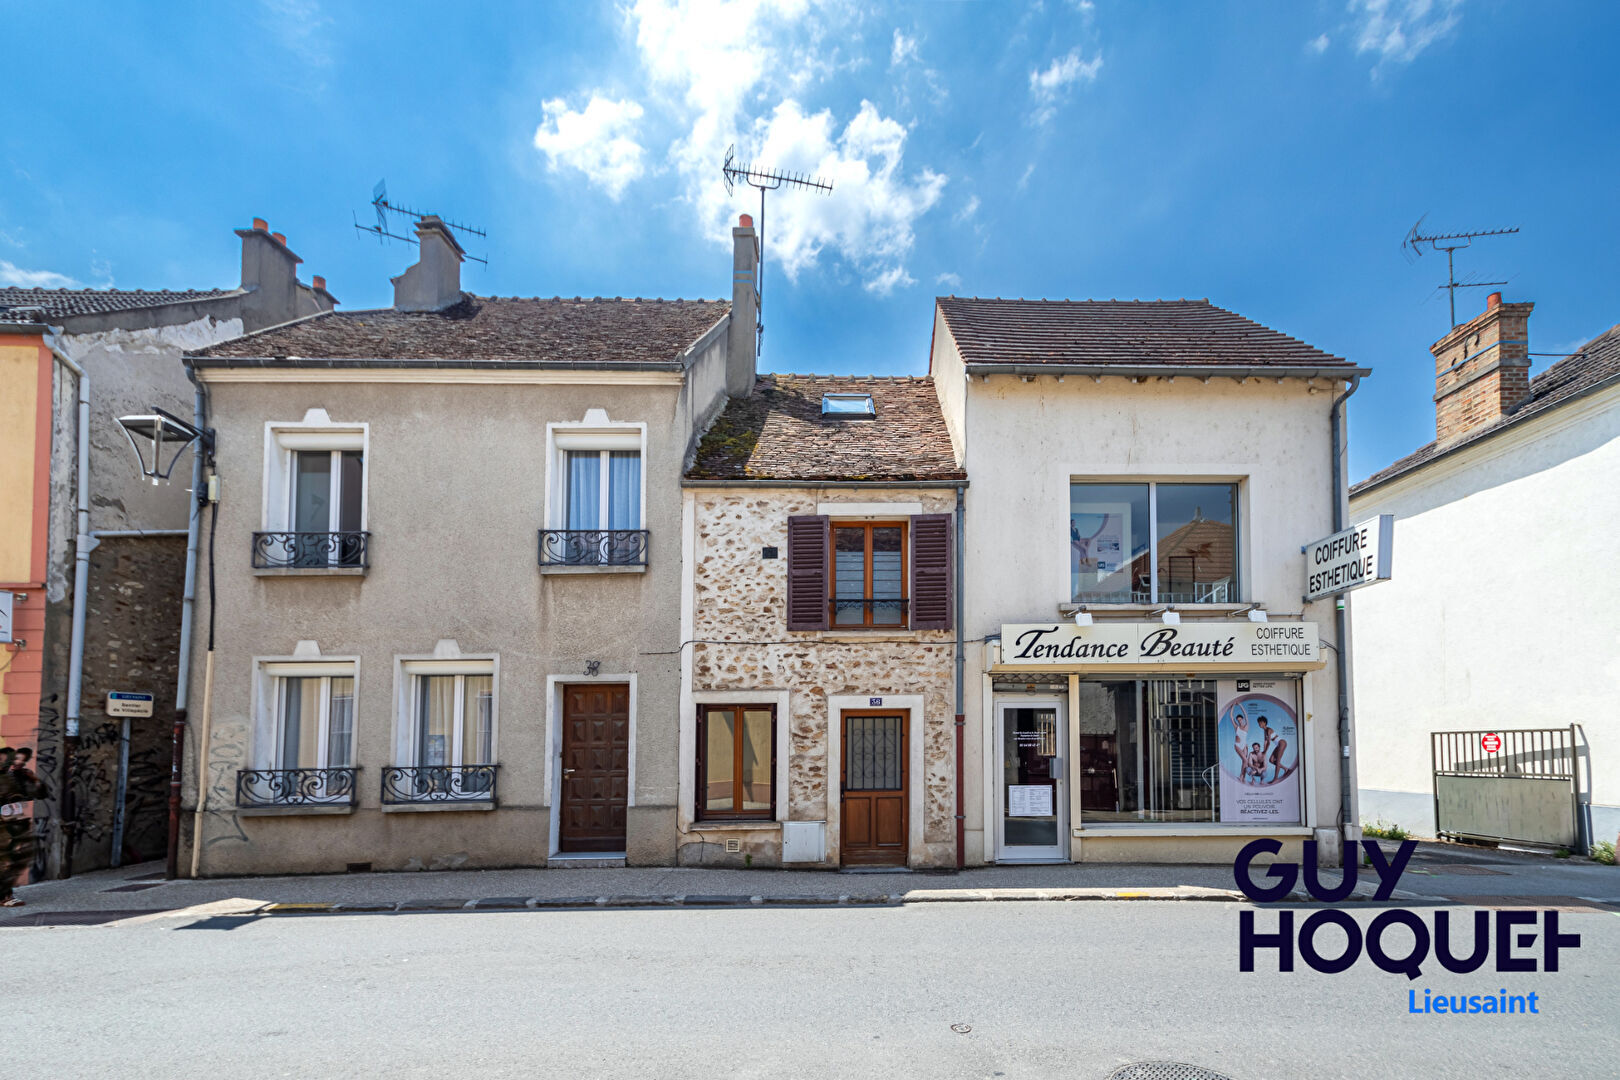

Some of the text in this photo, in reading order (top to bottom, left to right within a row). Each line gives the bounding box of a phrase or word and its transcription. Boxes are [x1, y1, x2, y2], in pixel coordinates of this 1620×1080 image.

[1315, 528, 1368, 565] COIFFURE
[1309, 554, 1374, 594] ESTHETIQUE
[1014, 625, 1236, 659] Tendance Beauté
[1256, 627, 1305, 640] COIFFURE
[1251, 643, 1312, 656] ESTHETIQUE
[582, 659, 601, 677] 38
